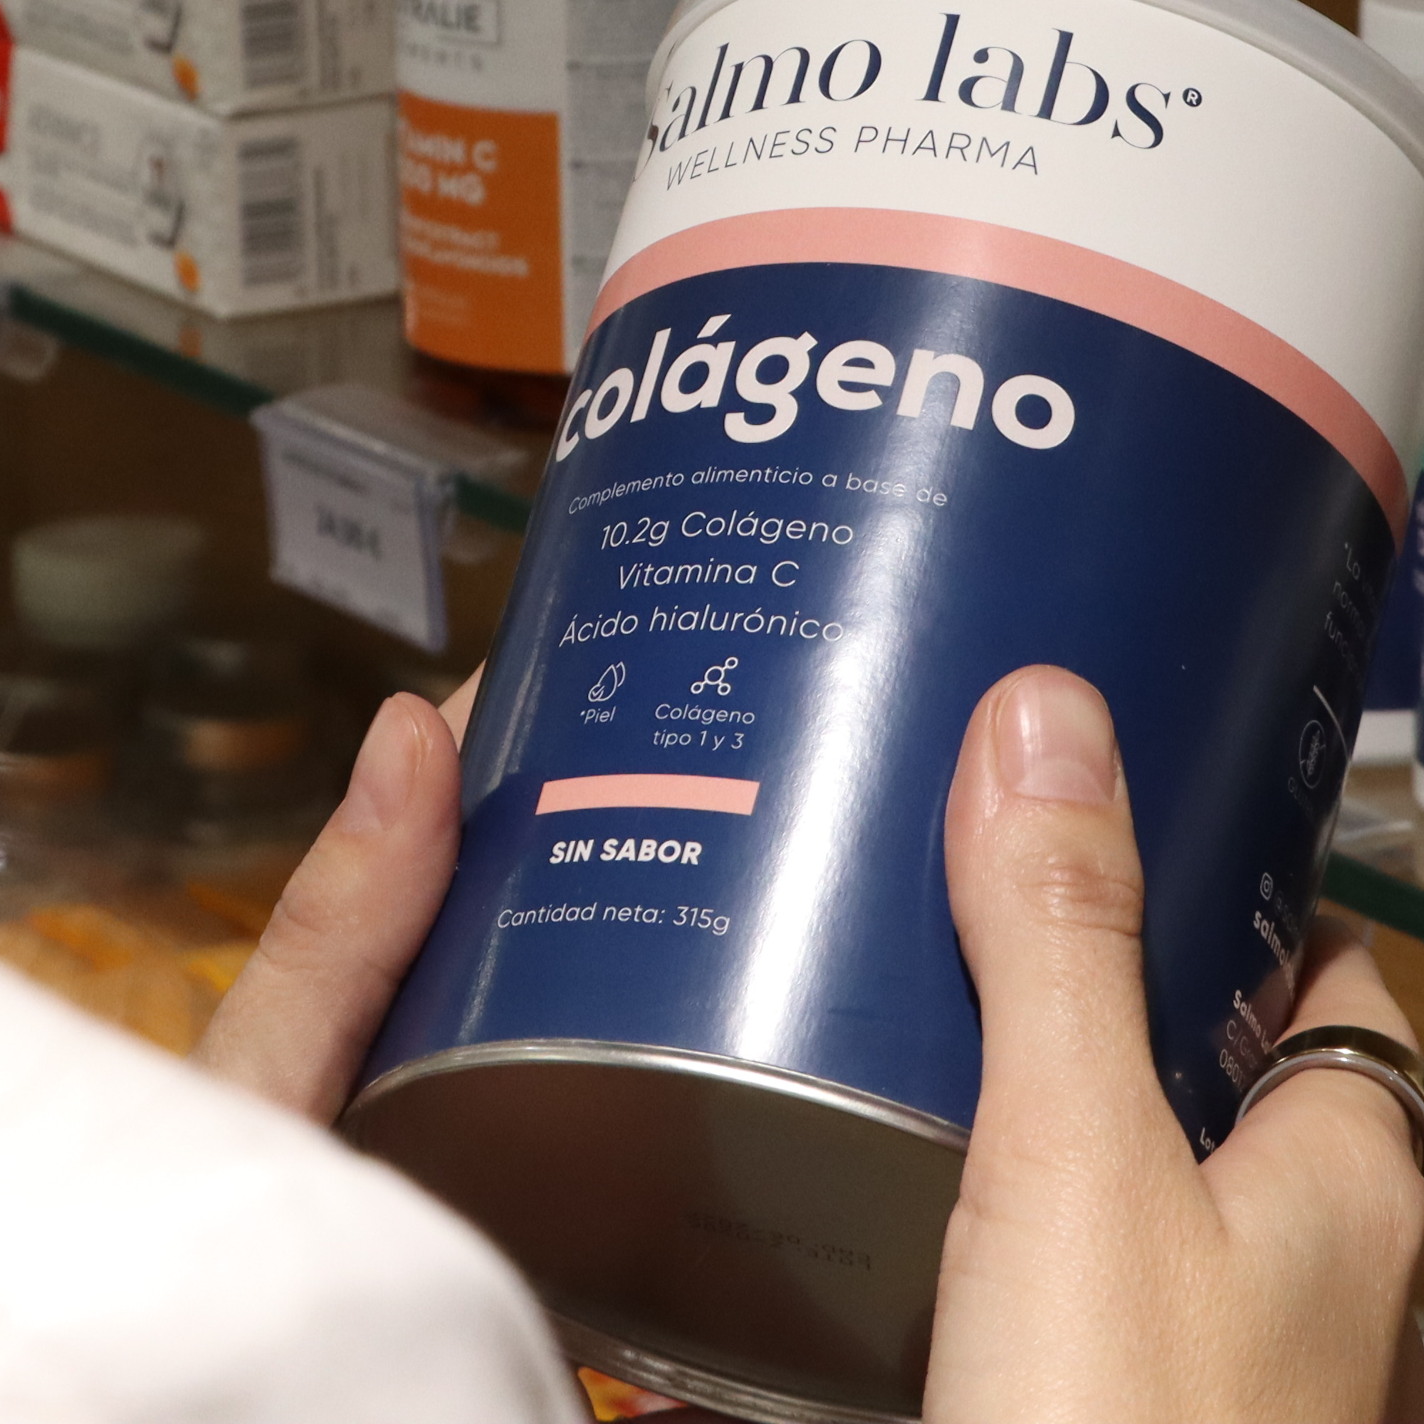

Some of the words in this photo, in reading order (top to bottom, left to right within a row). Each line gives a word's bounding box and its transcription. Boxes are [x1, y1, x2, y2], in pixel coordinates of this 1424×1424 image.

[667, 126, 838, 191] WELLNESS
[854, 126, 1041, 176] PHARMA
[555, 313, 1075, 463] colágeno
[568, 471, 685, 515] Complemento
[691, 466, 814, 486] alimenticio
[821, 473, 838, 488] a
[846, 472, 906, 497] base
[916, 485, 949, 507] de
[600, 516, 670, 552] 10.2g
[681, 509, 854, 546] Colágeno
[617, 556, 757, 591] Vitamina
[771, 560, 800, 588] C
[558, 609, 639, 648] Ácido
[648, 603, 844, 643] hialurónico
[654, 703, 756, 726] Colágeno
[652, 729, 692, 749] tipo
[699, 730, 707, 746] 1
[712, 735, 725, 751] y
[730, 732, 745, 750] 3
[549, 838, 594, 864] SIN
[599, 837, 703, 865] SABOR
[497, 901, 598, 929] Cantidad
[602, 904, 666, 925] neta:
[672, 905, 731, 936] 315g
